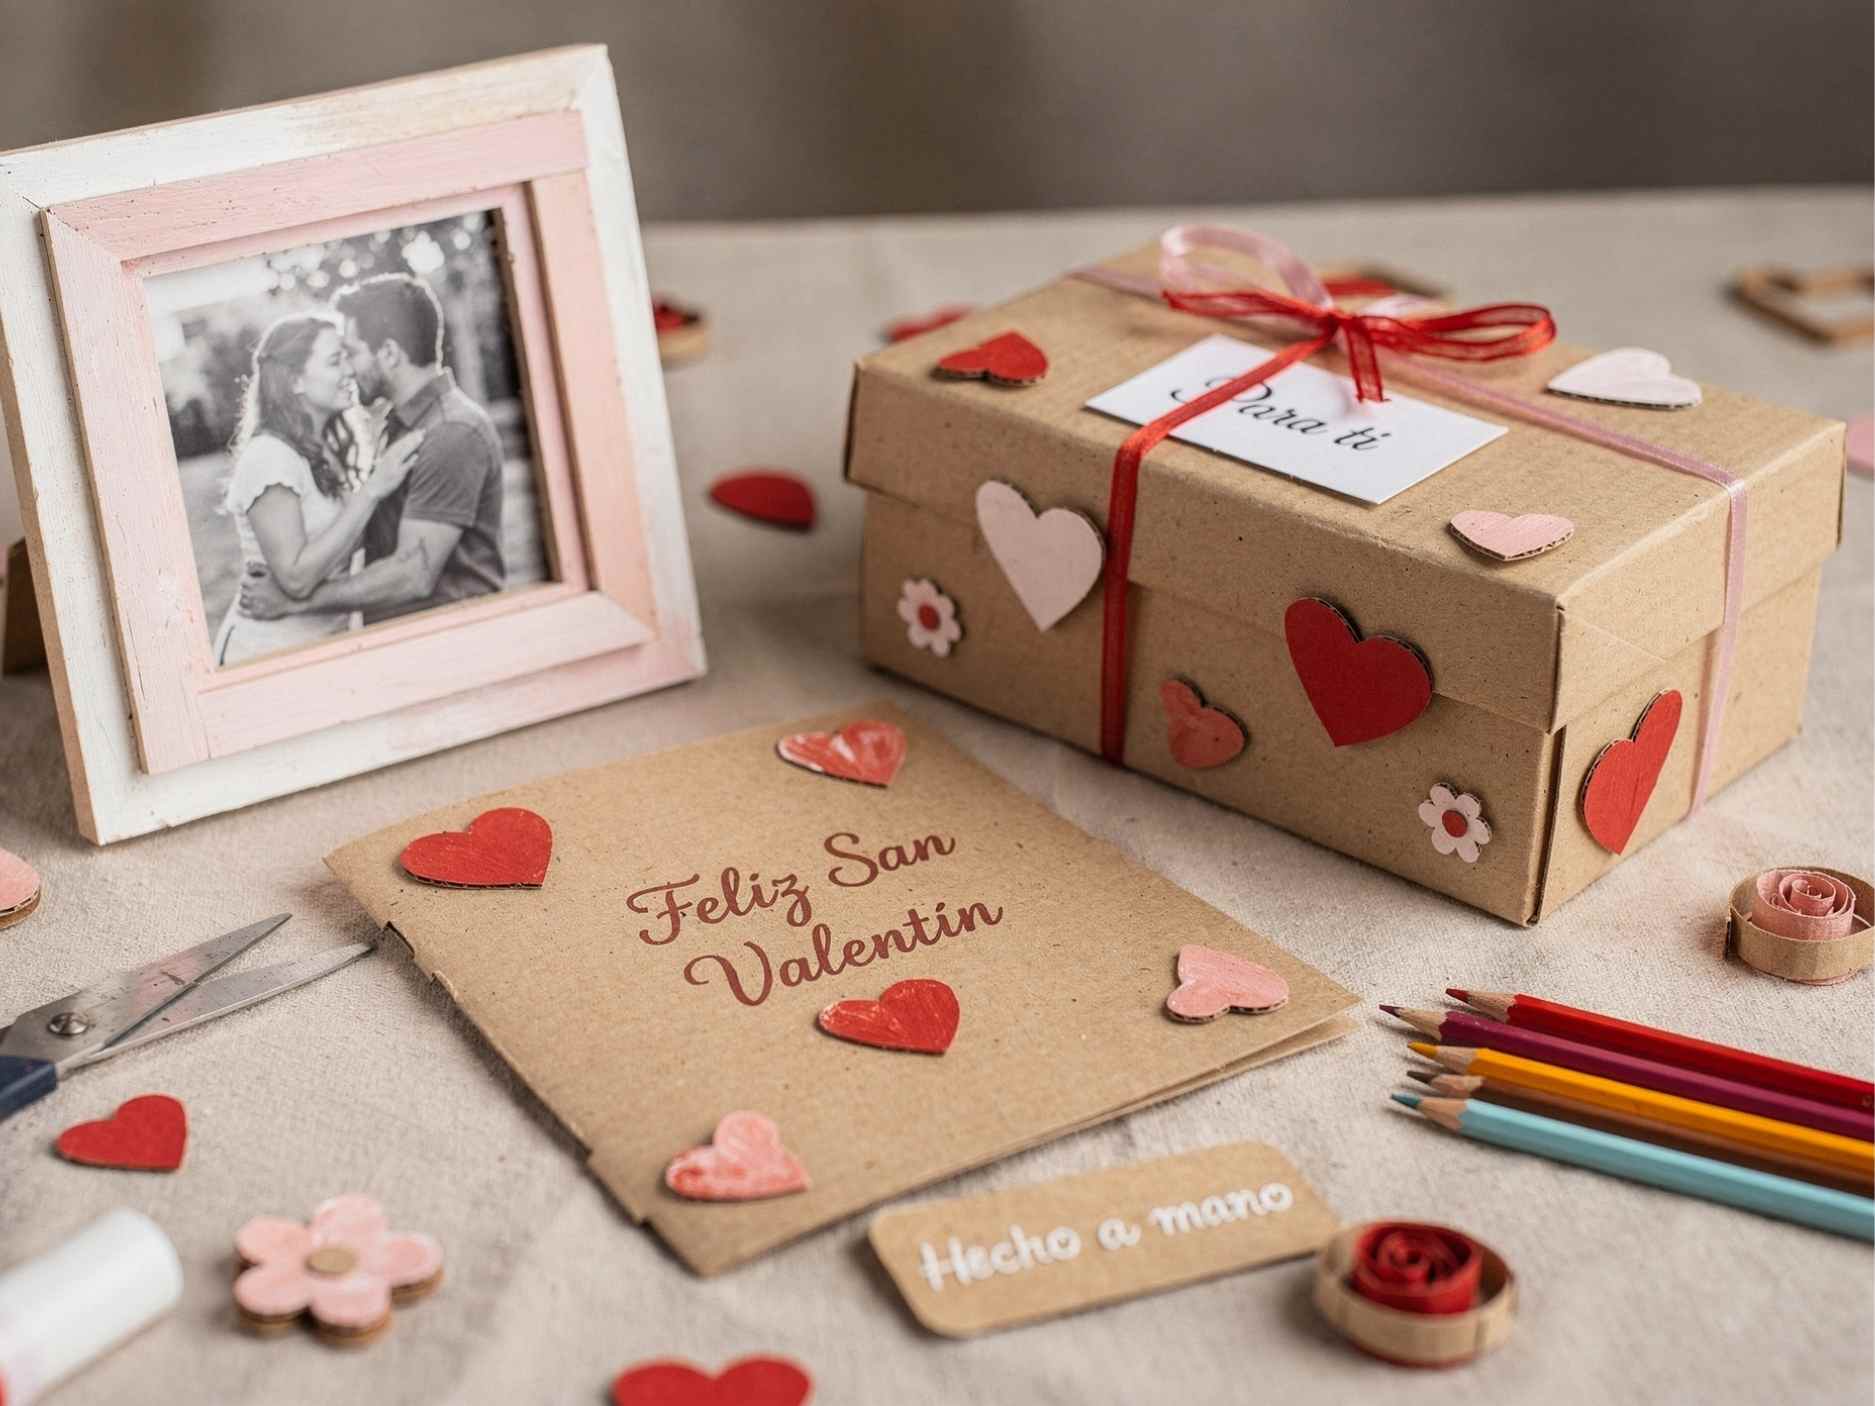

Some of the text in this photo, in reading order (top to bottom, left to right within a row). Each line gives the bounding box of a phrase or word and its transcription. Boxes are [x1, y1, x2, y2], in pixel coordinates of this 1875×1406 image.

[1333, 427, 1392, 451] ti
[626, 832, 955, 945] Feliz San
[920, 1183, 1294, 1292] Hecho a mano
